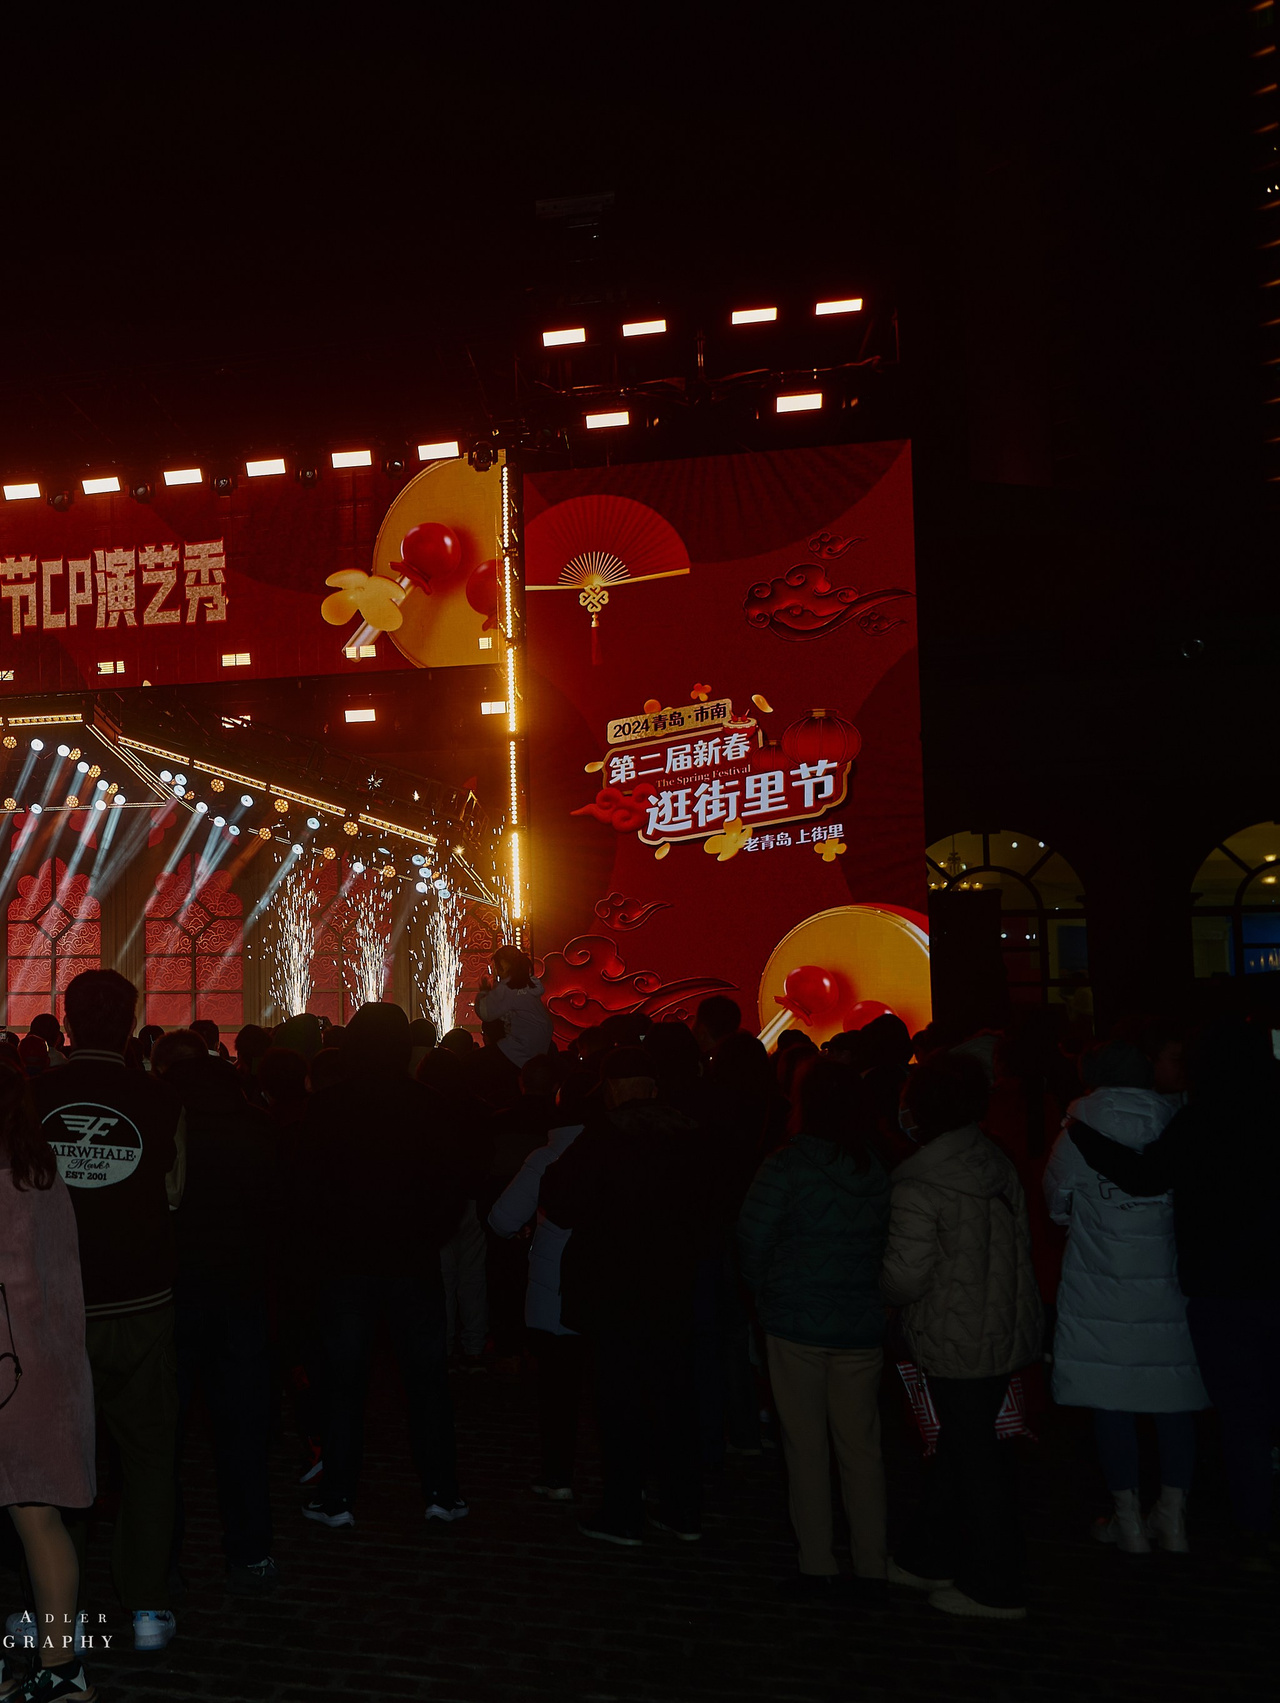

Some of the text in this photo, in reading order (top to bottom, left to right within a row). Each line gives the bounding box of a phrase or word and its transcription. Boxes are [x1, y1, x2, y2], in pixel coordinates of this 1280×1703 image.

[608, 732, 752, 785] 第二届新春
[655, 763, 752, 789] The Spring Festival
[646, 758, 839, 836] 逛街里节
[65, 1171, 107, 1181] EST 2001
